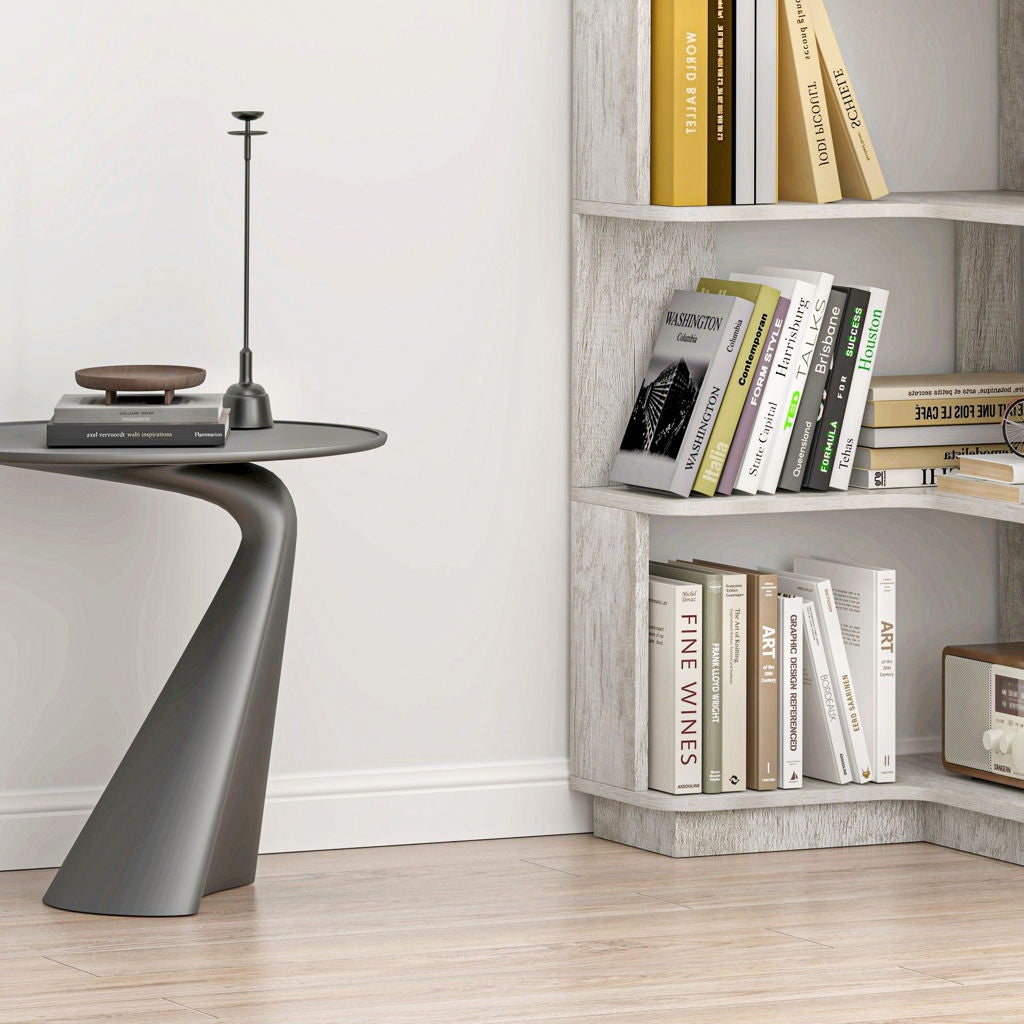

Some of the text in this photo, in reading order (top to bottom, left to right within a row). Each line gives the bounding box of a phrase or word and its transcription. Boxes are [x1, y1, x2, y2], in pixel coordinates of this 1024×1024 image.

[665, 311, 723, 331] WASHINGTON
[676, 332, 698, 344] Columbia
[750, 318, 783, 406] FORM STYLE
[784, 299, 826, 431] TED TALKS
[685, 319, 743, 470] WASHINGTON Columbia
[703, 313, 768, 483] Italia Contemporan
[749, 297, 810, 477] State Capital Harrisburg
[793, 306, 841, 477] Queensland Brisbane
[820, 307, 863, 473] FORMULA FOR SUCCESS
[838, 309, 882, 470] Tehas Houston
[141, 431, 173, 439] inspirations
[762, 625, 776, 659] ART
[881, 620, 893, 653] ART
[680, 615, 697, 765] FINE WINES
[711, 643, 720, 723] FRANK LLOYD WRIGHT
[821, 674, 837, 722] BORDEAUX
[842, 674, 860, 732] EERO SAARINEN
